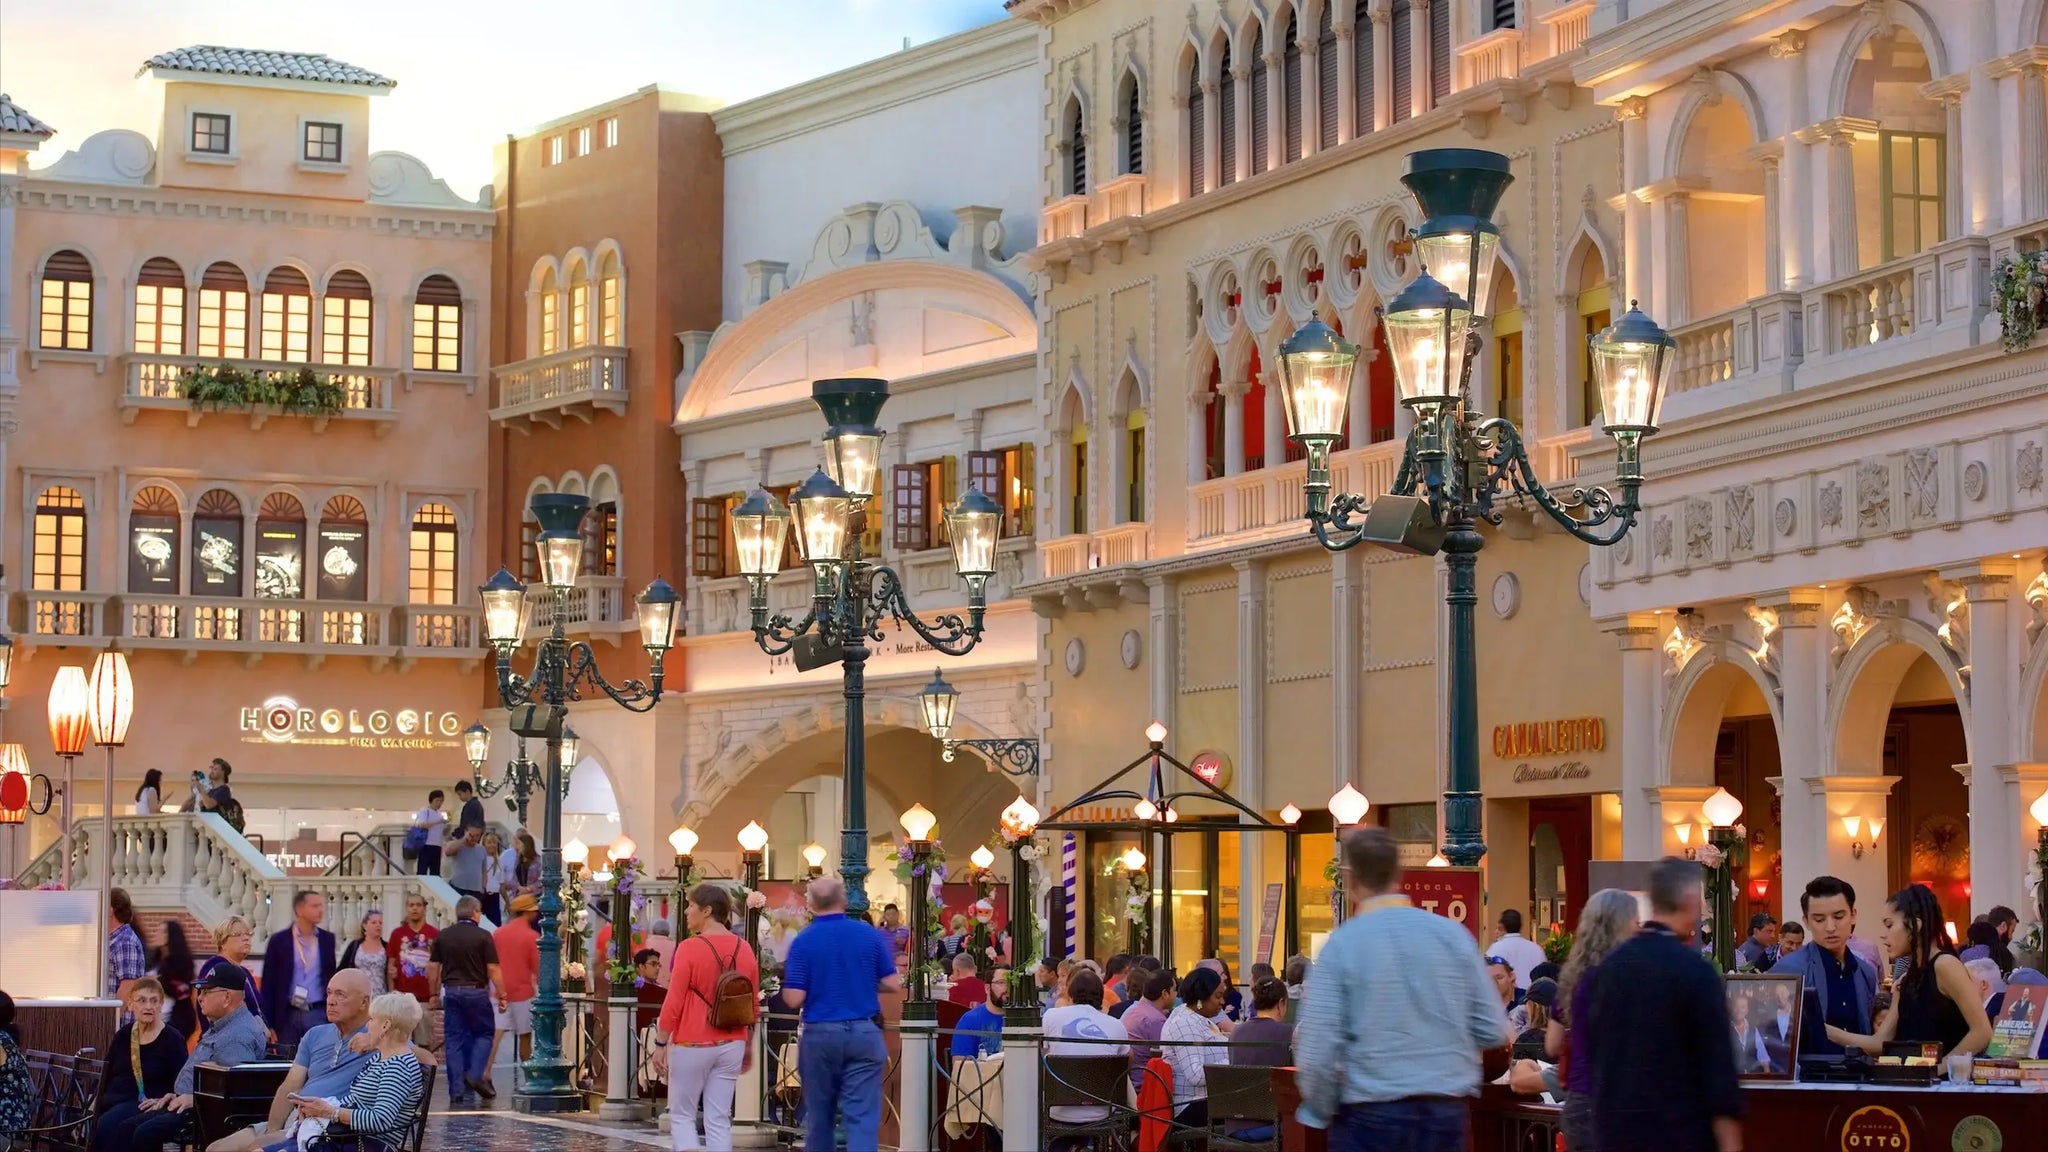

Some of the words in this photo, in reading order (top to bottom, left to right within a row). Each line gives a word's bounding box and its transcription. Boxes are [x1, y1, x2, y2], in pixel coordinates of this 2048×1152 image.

[896, 643, 914, 654] More
[240, 704, 462, 737] HOROLOGIO
[380, 737, 434, 750] WATCHES
[1493, 717, 1605, 758] CANALETTO
[1996, 1019, 2033, 1030] AMERICA
